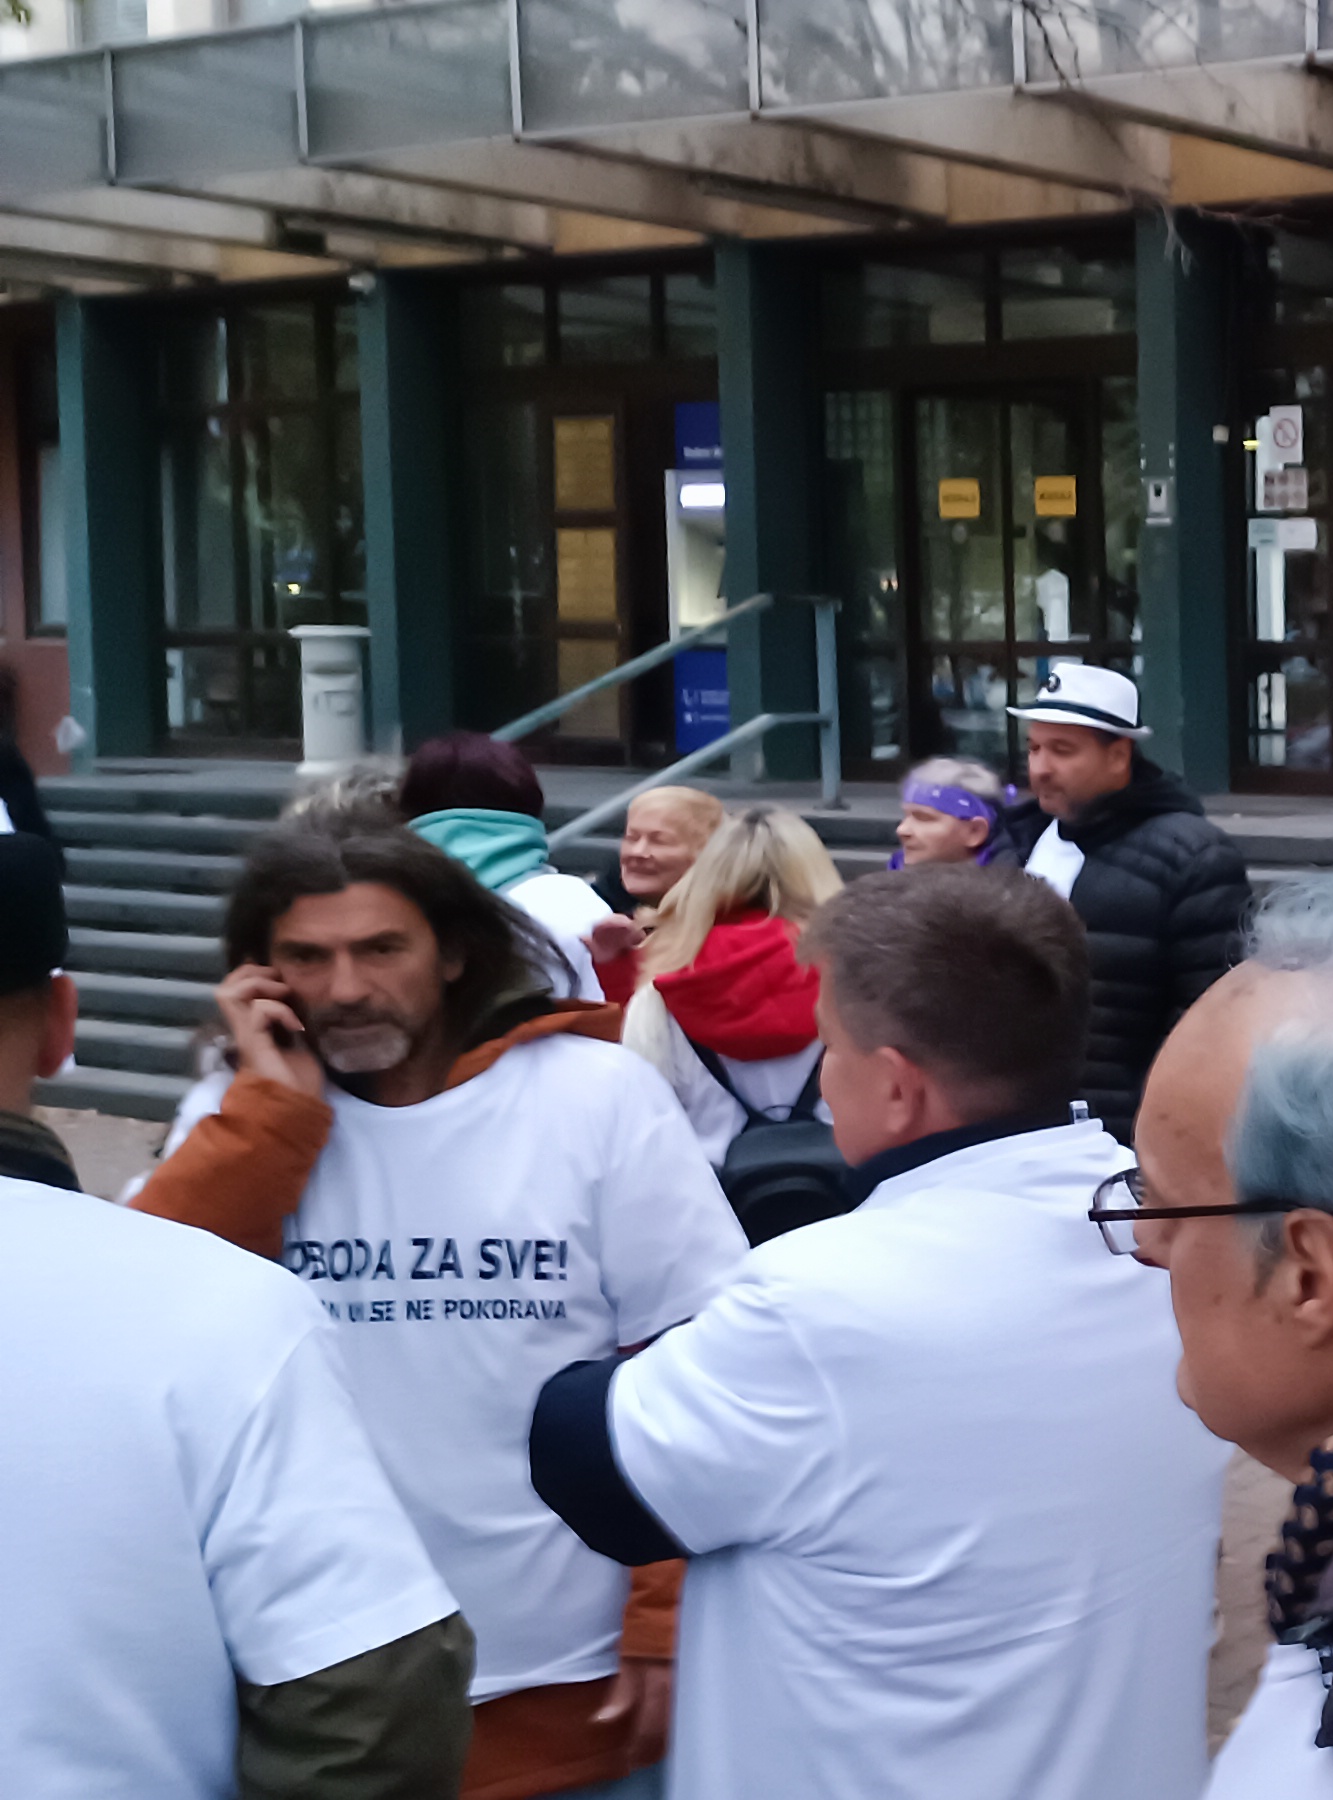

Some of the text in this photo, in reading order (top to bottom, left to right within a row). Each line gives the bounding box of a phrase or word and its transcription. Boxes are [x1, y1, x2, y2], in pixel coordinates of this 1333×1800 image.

[284, 1237, 568, 1282] OBODA ZA SVE!
[369, 1300, 396, 1322] SE
[405, 1299, 434, 1320] NE
[444, 1299, 567, 1321] POKORAVA
